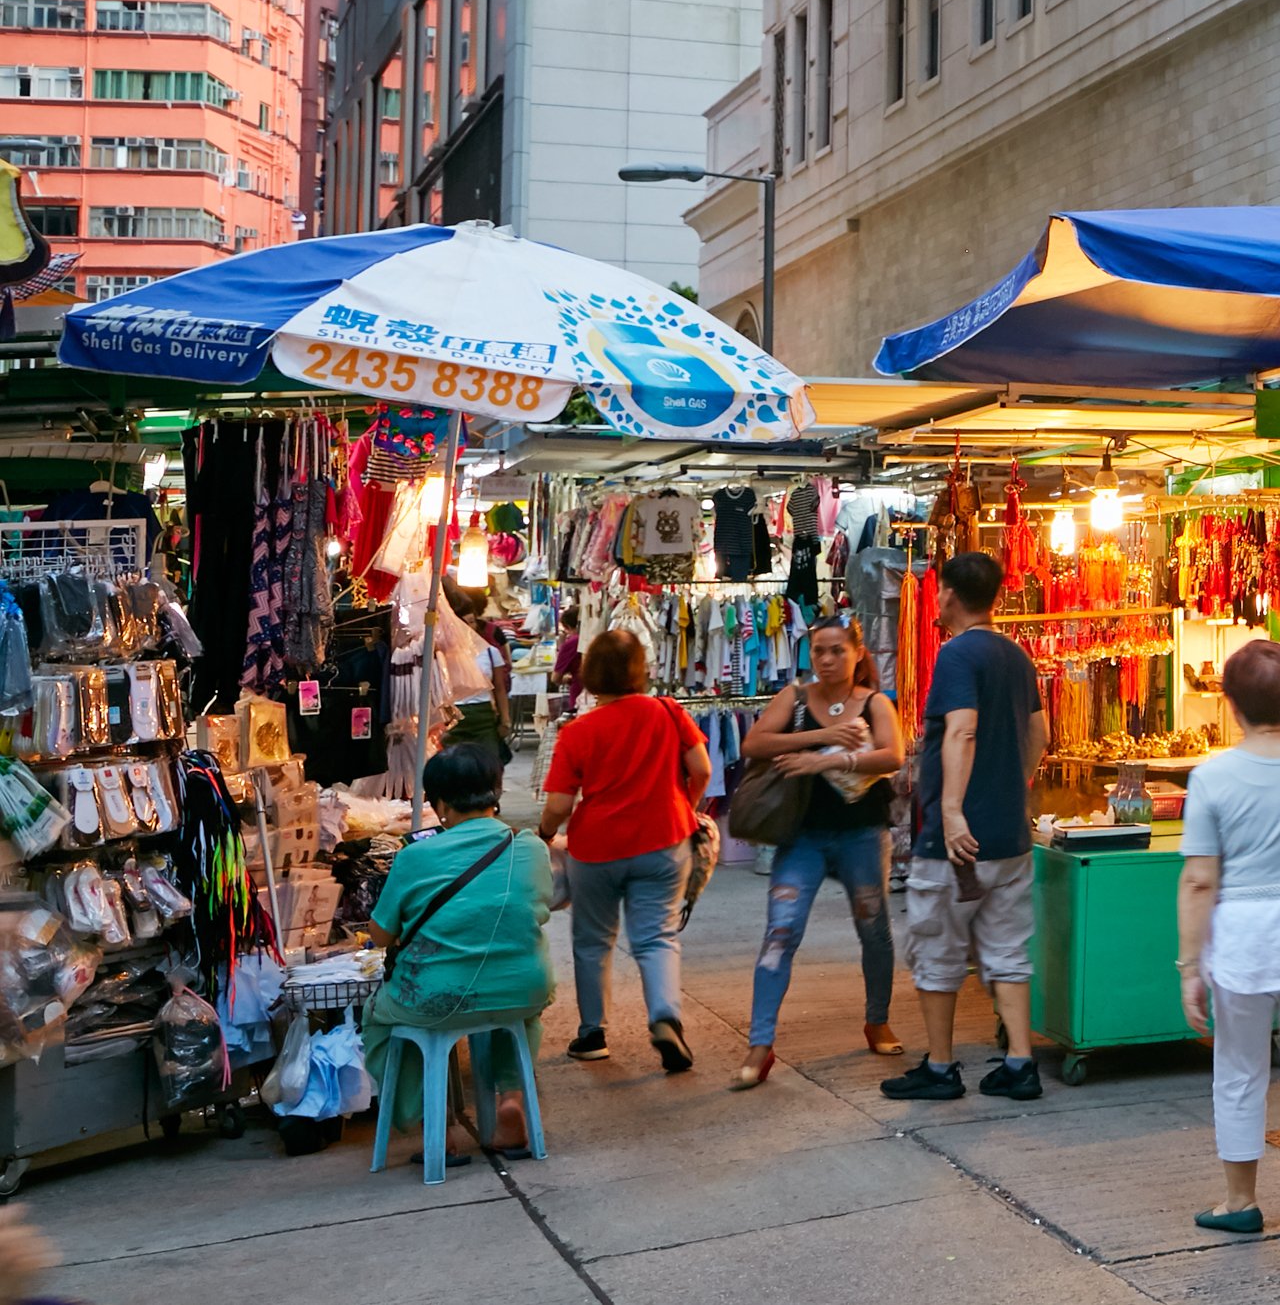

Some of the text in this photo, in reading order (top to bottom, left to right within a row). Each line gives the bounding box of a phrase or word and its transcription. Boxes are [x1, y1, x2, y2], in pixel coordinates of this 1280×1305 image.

[321, 304, 440, 346] 蜆殼
[81, 331, 249, 367] Shell Gas Delivery
[316, 327, 553, 375] Shell Gas Delivery
[302, 342, 544, 411] 2435 8388
[663, 395, 687, 408] Shell
